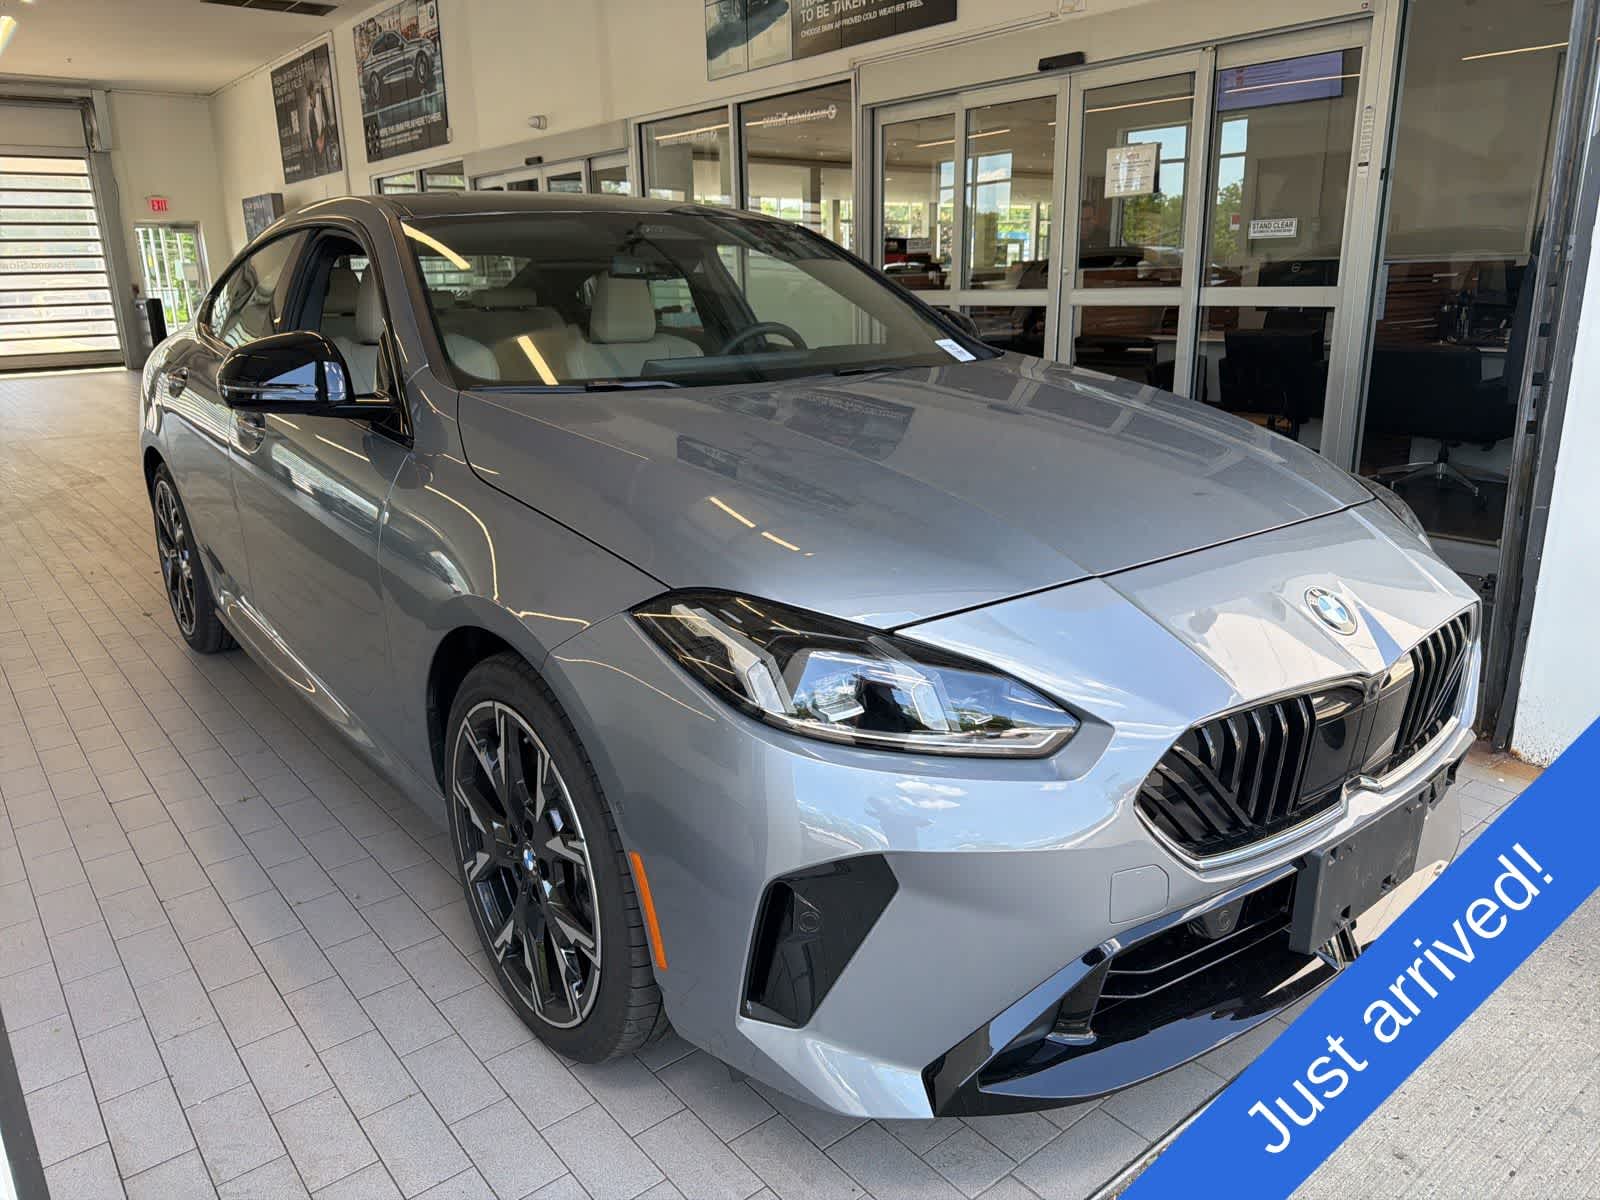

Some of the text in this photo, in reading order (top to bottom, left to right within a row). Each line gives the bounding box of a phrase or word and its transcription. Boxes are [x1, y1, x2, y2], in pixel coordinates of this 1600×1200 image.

[800, 8, 814, 24] TO
[816, 3, 830, 18] BE
[862, 10, 878, 21] COLD
[151, 199, 168, 212] EXIT
[1252, 221, 1293, 230] STAND CLEAR
